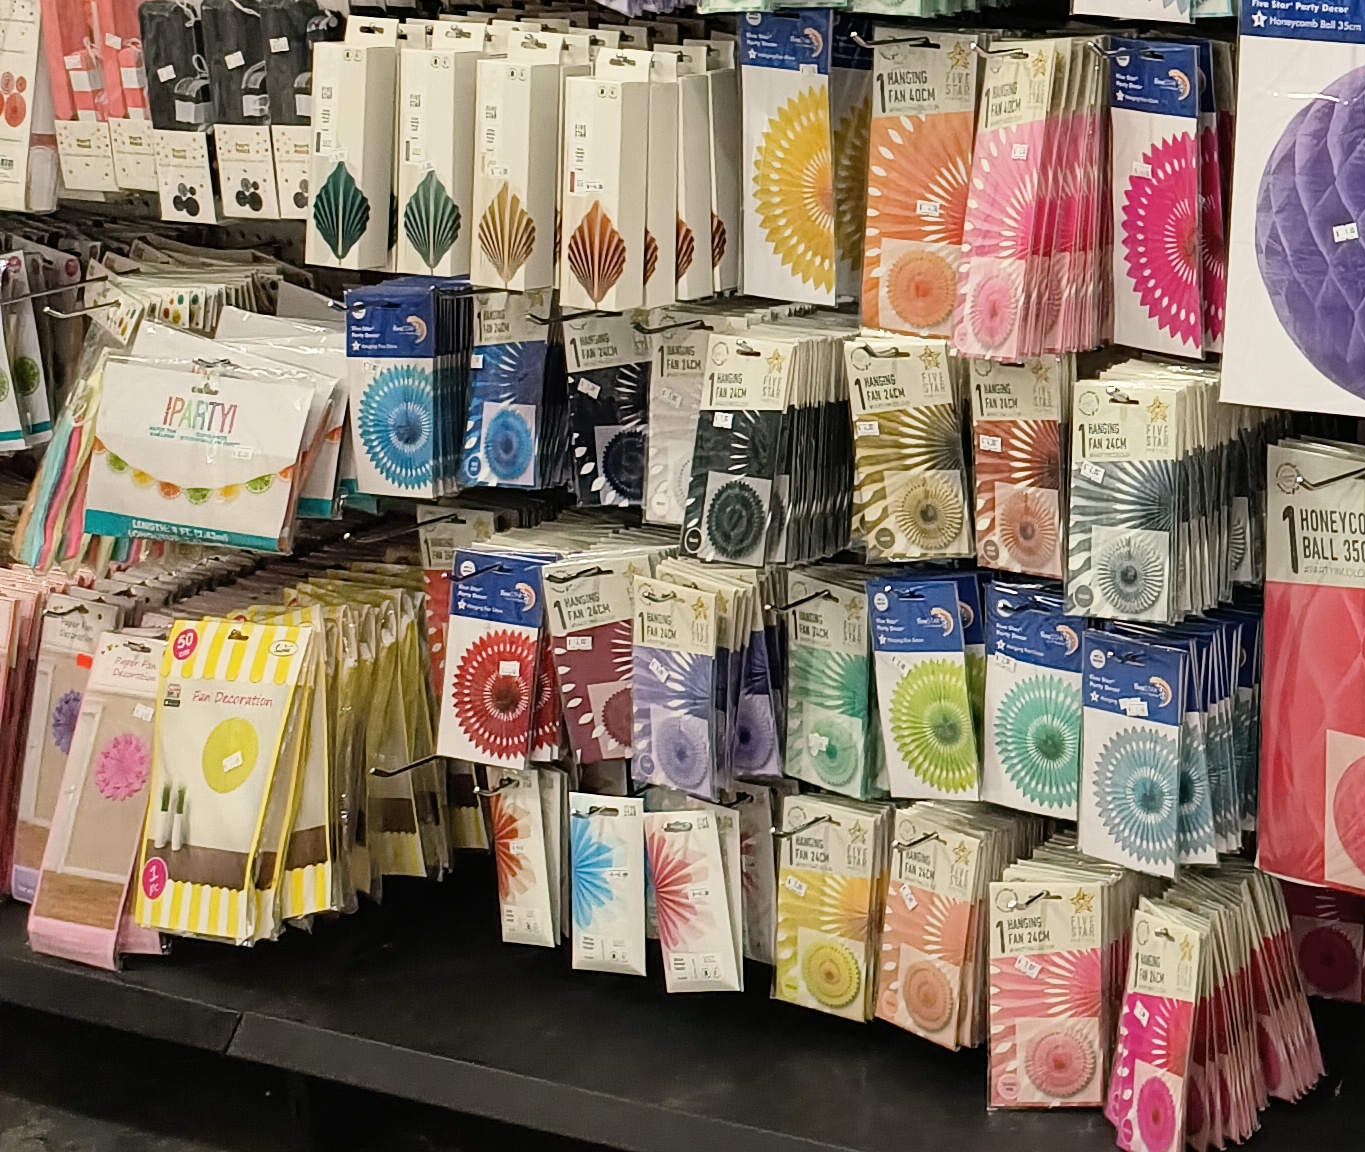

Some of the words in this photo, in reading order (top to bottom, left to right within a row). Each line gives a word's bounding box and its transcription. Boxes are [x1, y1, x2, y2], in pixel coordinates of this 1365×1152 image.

[1078, 424, 1085, 459] 1
[1088, 437, 1104, 450] FAN
[1107, 437, 1127, 450] 24CM
[1283, 505, 1299, 575] 1
[1303, 539, 1339, 563] BALL
[176, 633, 194, 650] 50
[192, 689, 211, 702] Fan
[214, 690, 274, 708] Decoration
[149, 866, 160, 882] 1
